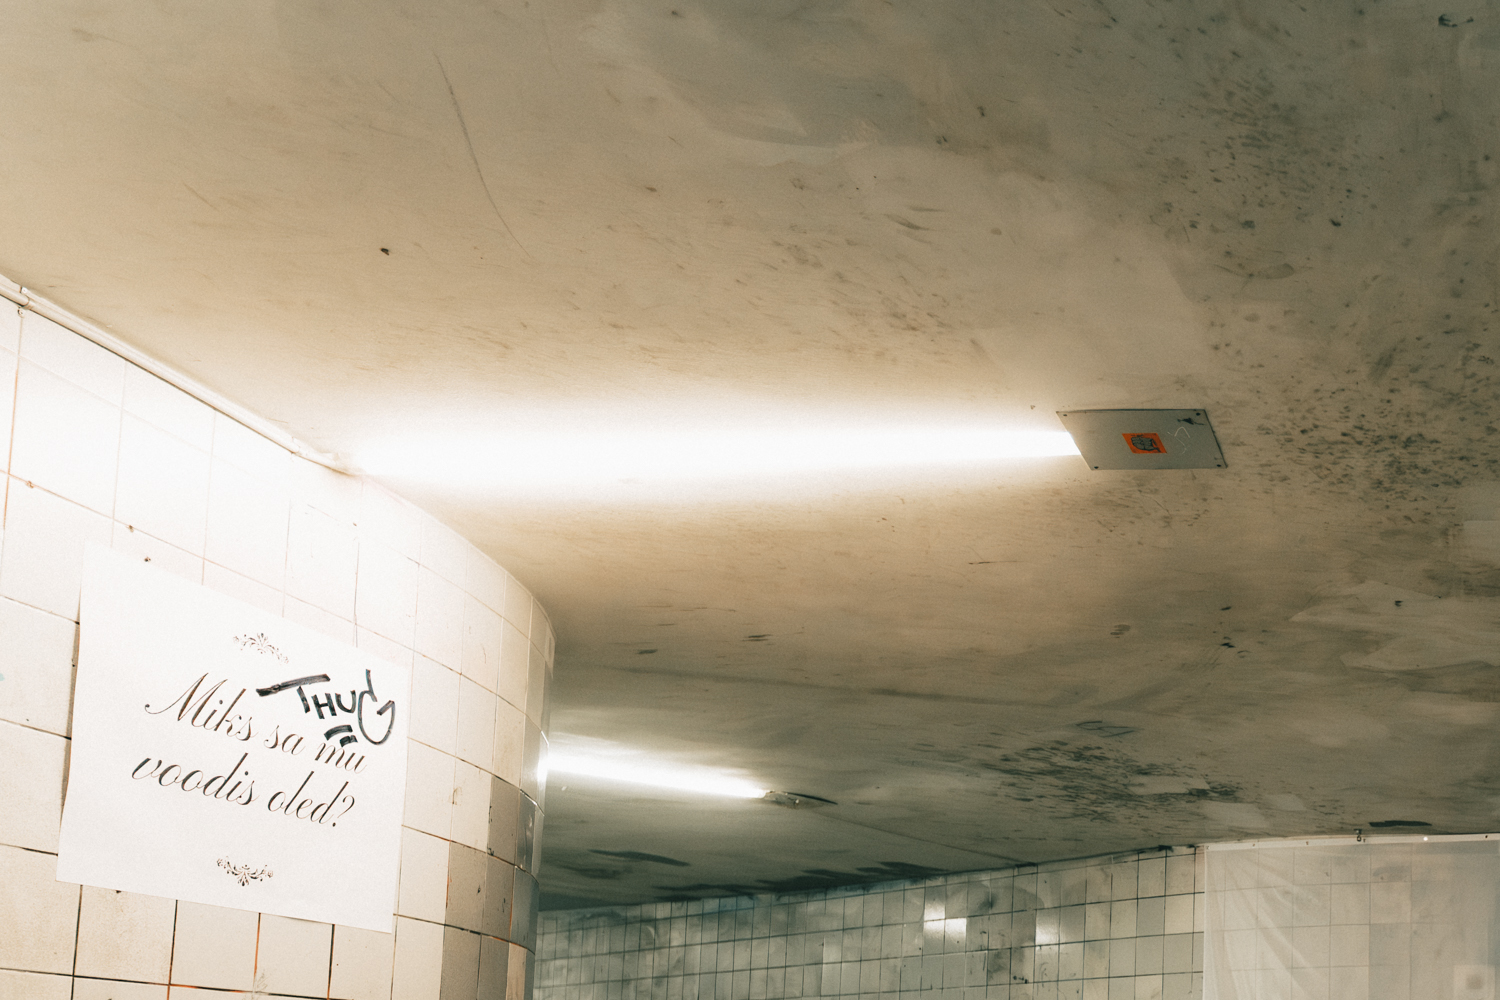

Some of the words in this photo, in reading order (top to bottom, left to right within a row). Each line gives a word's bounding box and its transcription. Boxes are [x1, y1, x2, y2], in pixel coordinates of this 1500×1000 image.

[144, 672, 259, 743] Miks
[263, 725, 306, 756] sa
[314, 742, 367, 774] mu
[256, 669, 395, 745] THUG
[131, 752, 260, 808] voodis
[267, 770, 356, 828] oled?
